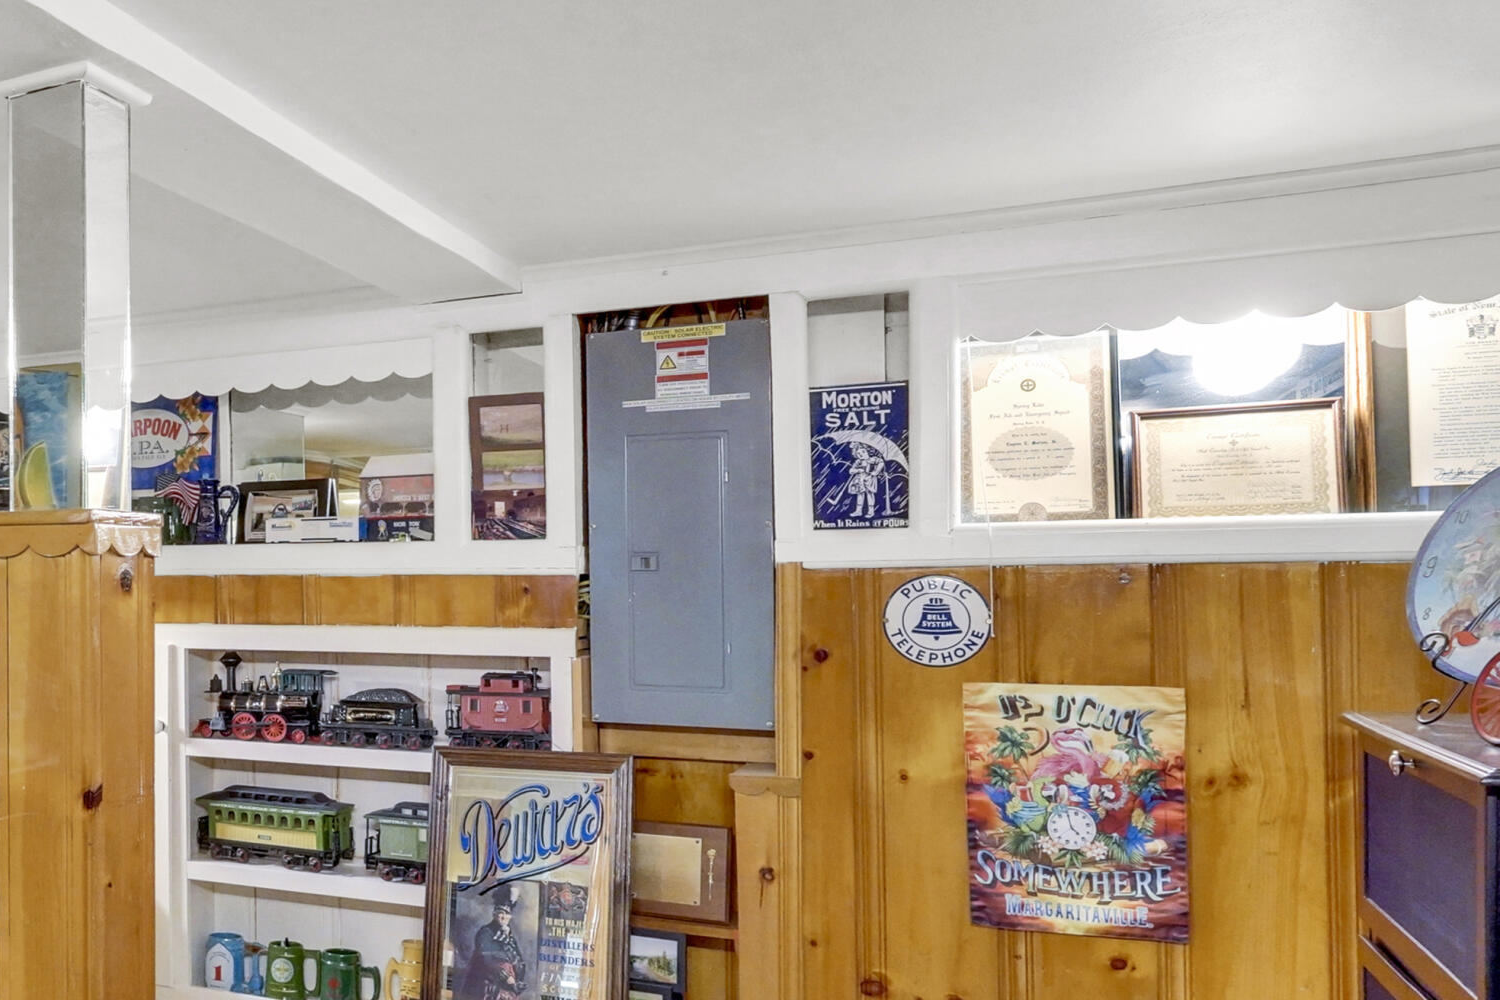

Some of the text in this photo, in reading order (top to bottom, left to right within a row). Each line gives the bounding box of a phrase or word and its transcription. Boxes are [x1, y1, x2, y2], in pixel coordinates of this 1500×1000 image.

[821, 390, 892, 409] MORTON
[825, 409, 891, 427] SALT
[845, 519, 870, 527] Rains
[900, 579, 972, 599] PUBLIC
[891, 628, 984, 663] TELEPHONE
[1054, 694, 1156, 750] O'CLOCK
[457, 782, 604, 892] Dewar's
[974, 850, 1182, 903] SOMEWHERE
[1004, 893, 1150, 928] MARGARITAVILLE
[551, 927, 566, 937] THE
[539, 938, 595, 951] DISTILLERS
[539, 952, 595, 967] BLENDERS
[212, 964, 222, 981] 1
